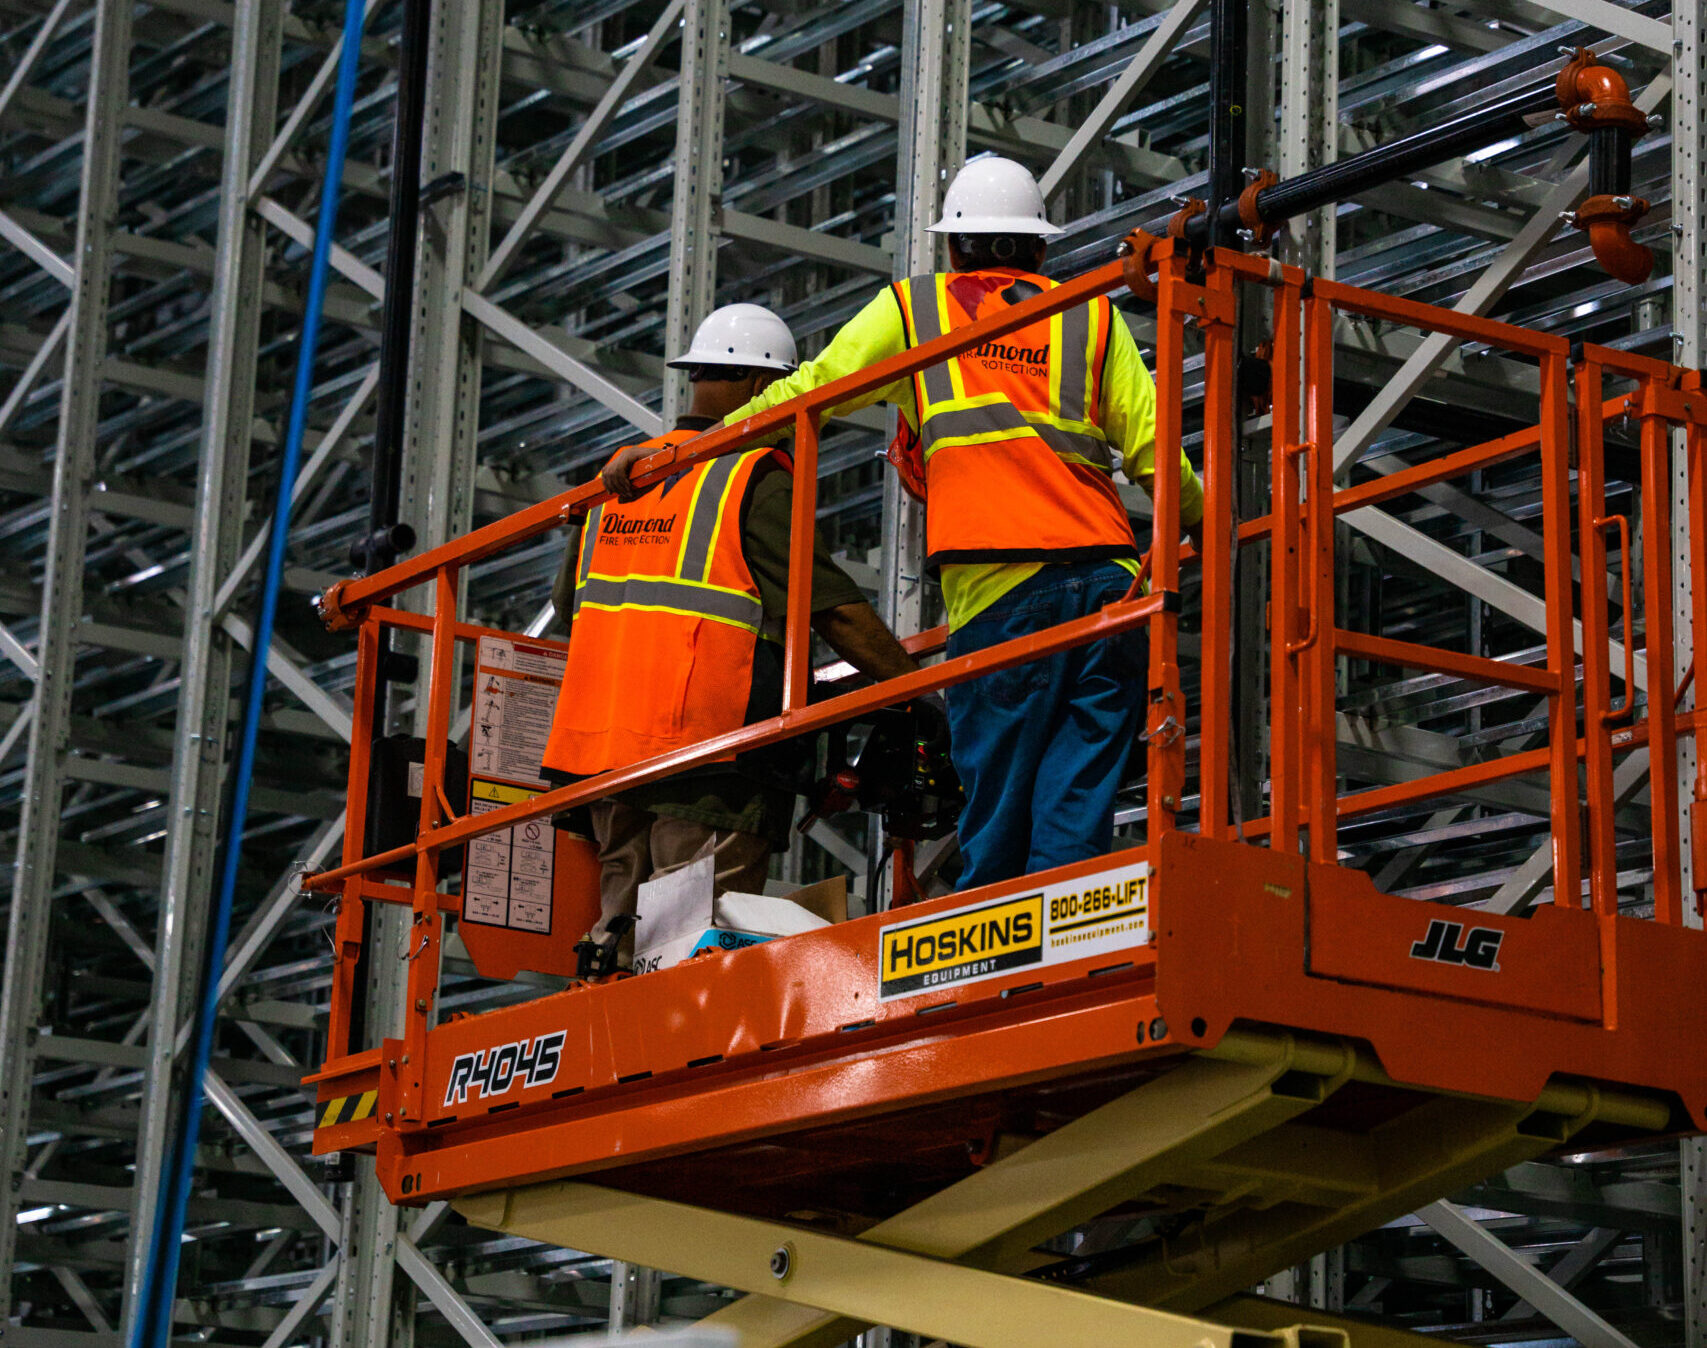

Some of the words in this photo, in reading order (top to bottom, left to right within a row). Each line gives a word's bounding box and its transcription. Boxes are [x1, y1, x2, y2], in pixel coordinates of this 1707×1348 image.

[977, 342, 1050, 364] amond
[981, 359, 1048, 377] ROTECTION
[603, 512, 677, 534] Diamond
[600, 535, 620, 546] FIRE
[624, 534, 671, 546] PROECTION
[1050, 876, 1148, 923] 800-266-LIFT
[890, 911, 1034, 973] HOSKINS
[1409, 919, 1504, 972] JLG
[922, 959, 997, 986] EQUIPMENT
[443, 1029, 568, 1107] R4045
